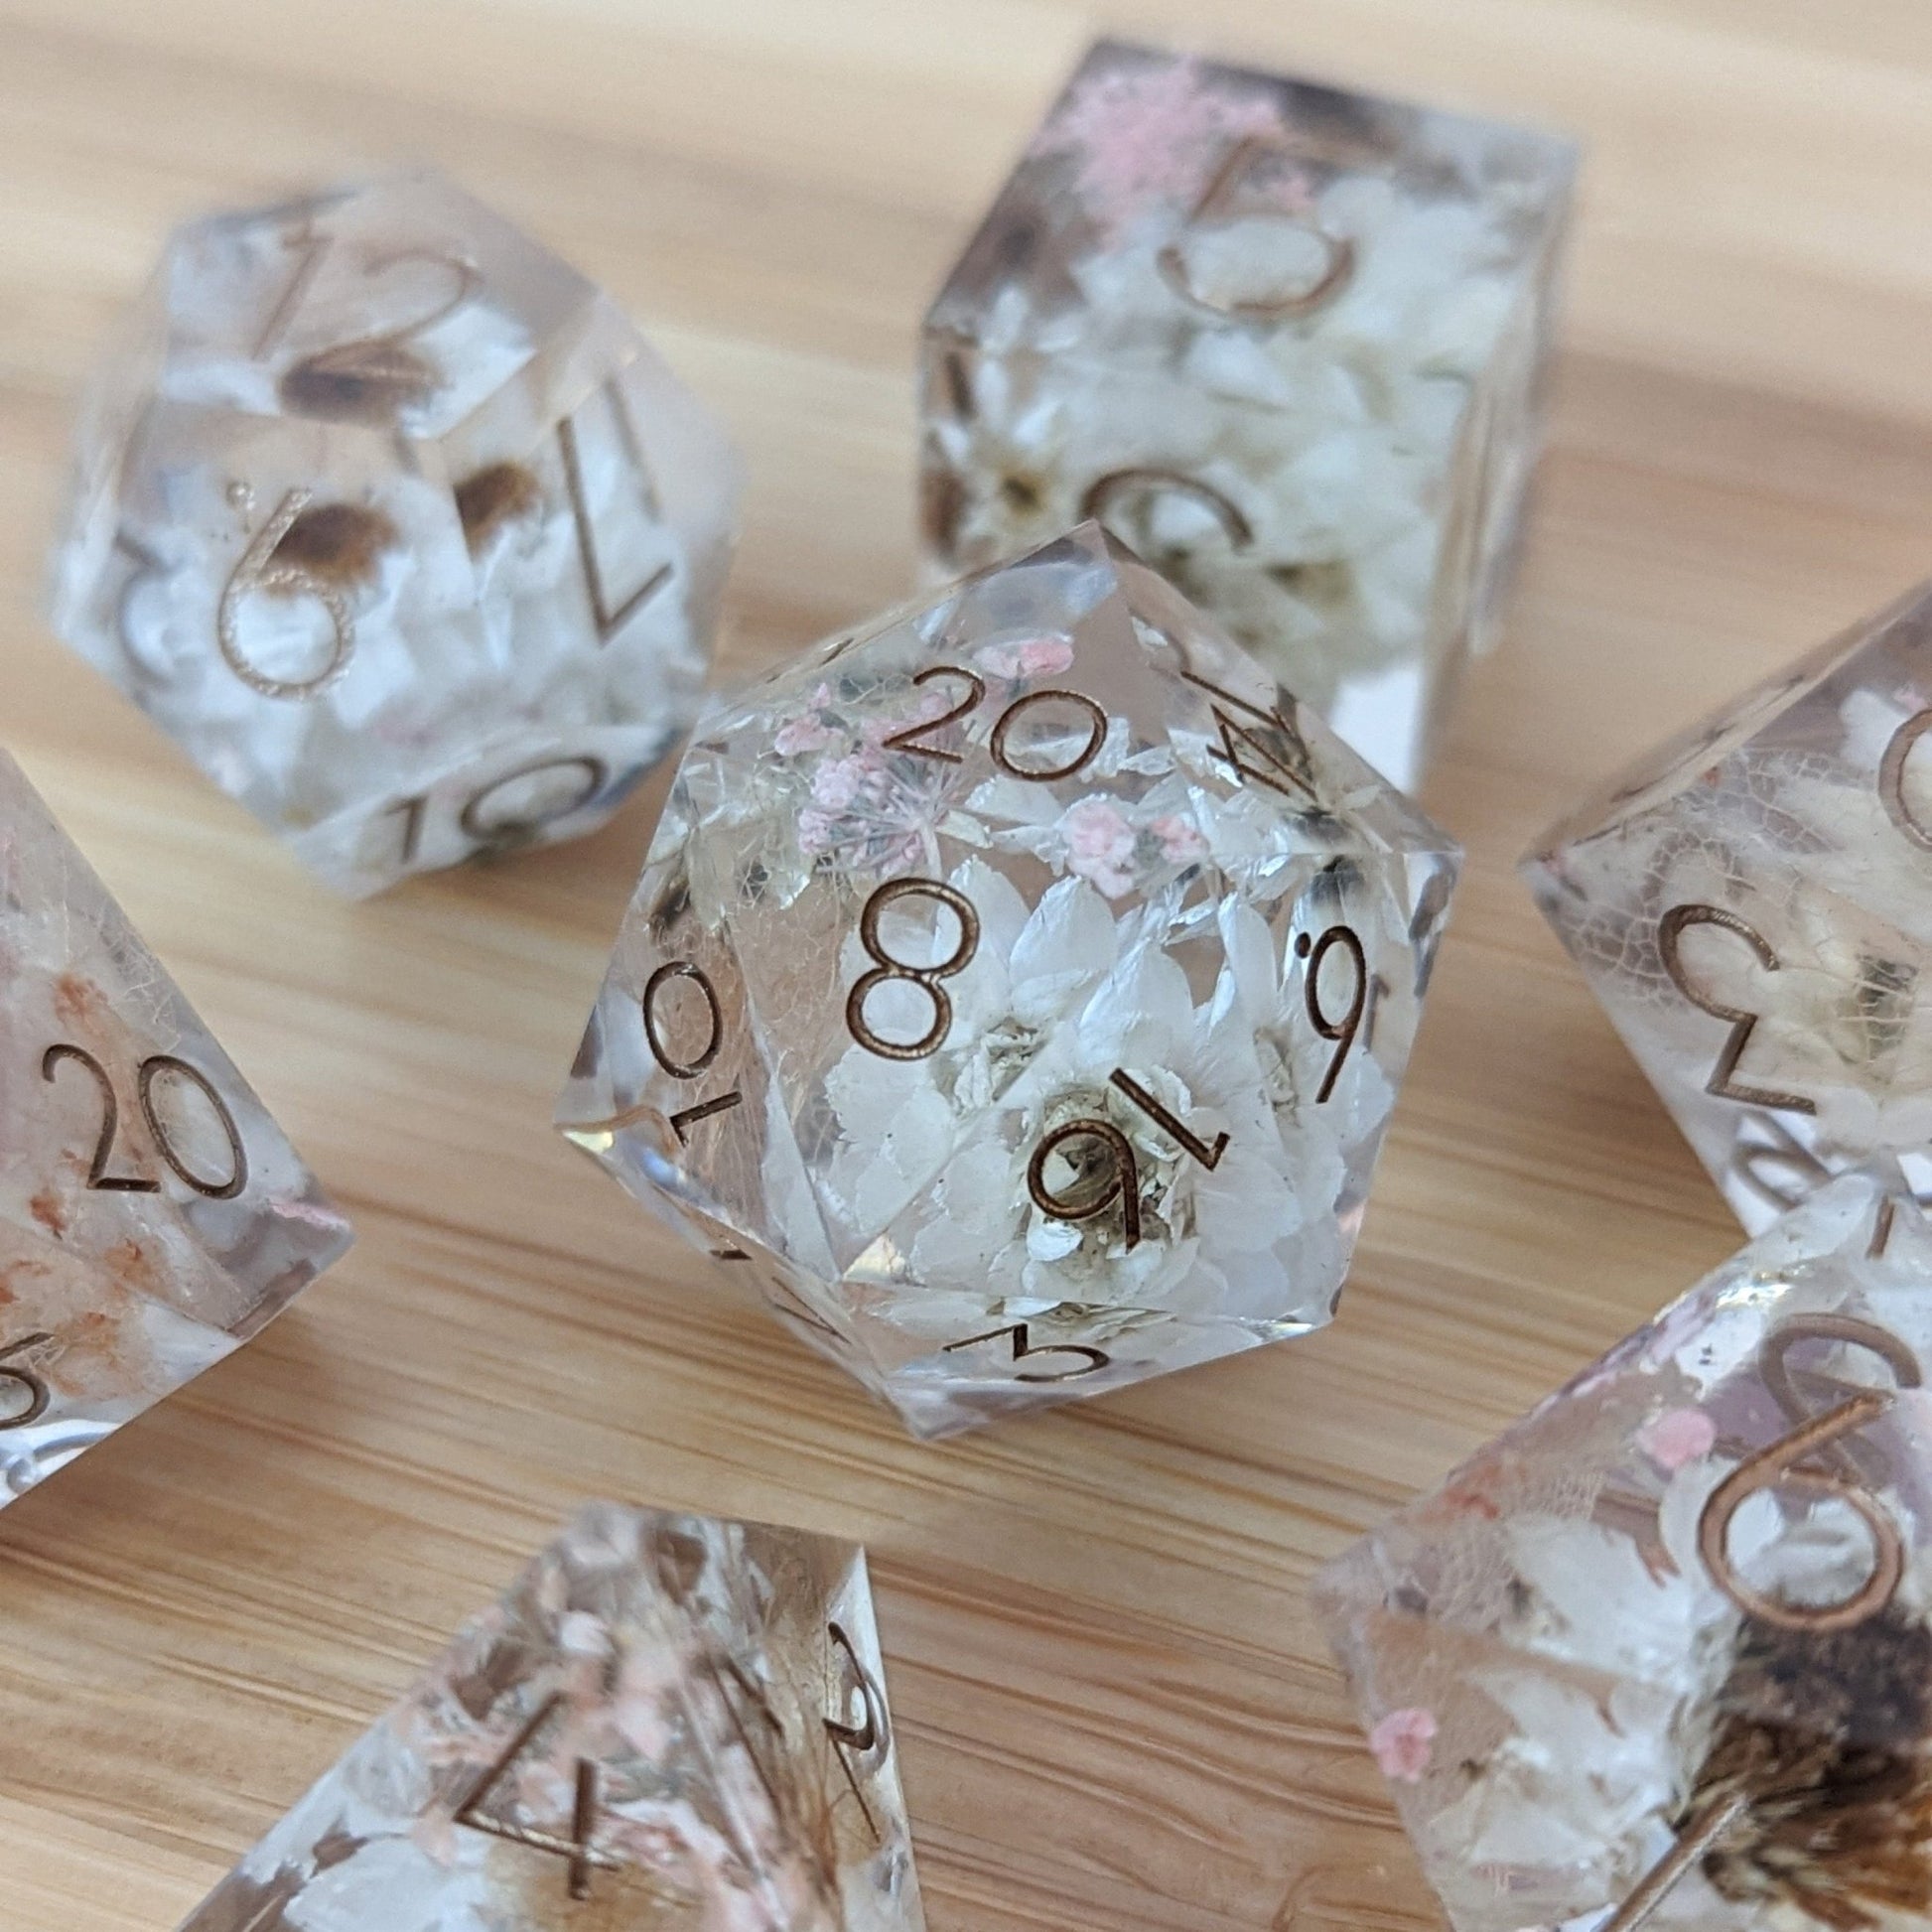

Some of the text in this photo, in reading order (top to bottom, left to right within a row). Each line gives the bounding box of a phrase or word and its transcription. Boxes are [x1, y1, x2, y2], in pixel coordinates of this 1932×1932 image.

[882, 666, 1108, 782] 20
[383, 755, 610, 864] 10
[847, 877, 981, 1060] 8
[42, 1043, 248, 1199] 20
[454, 1688, 618, 1900] 4
